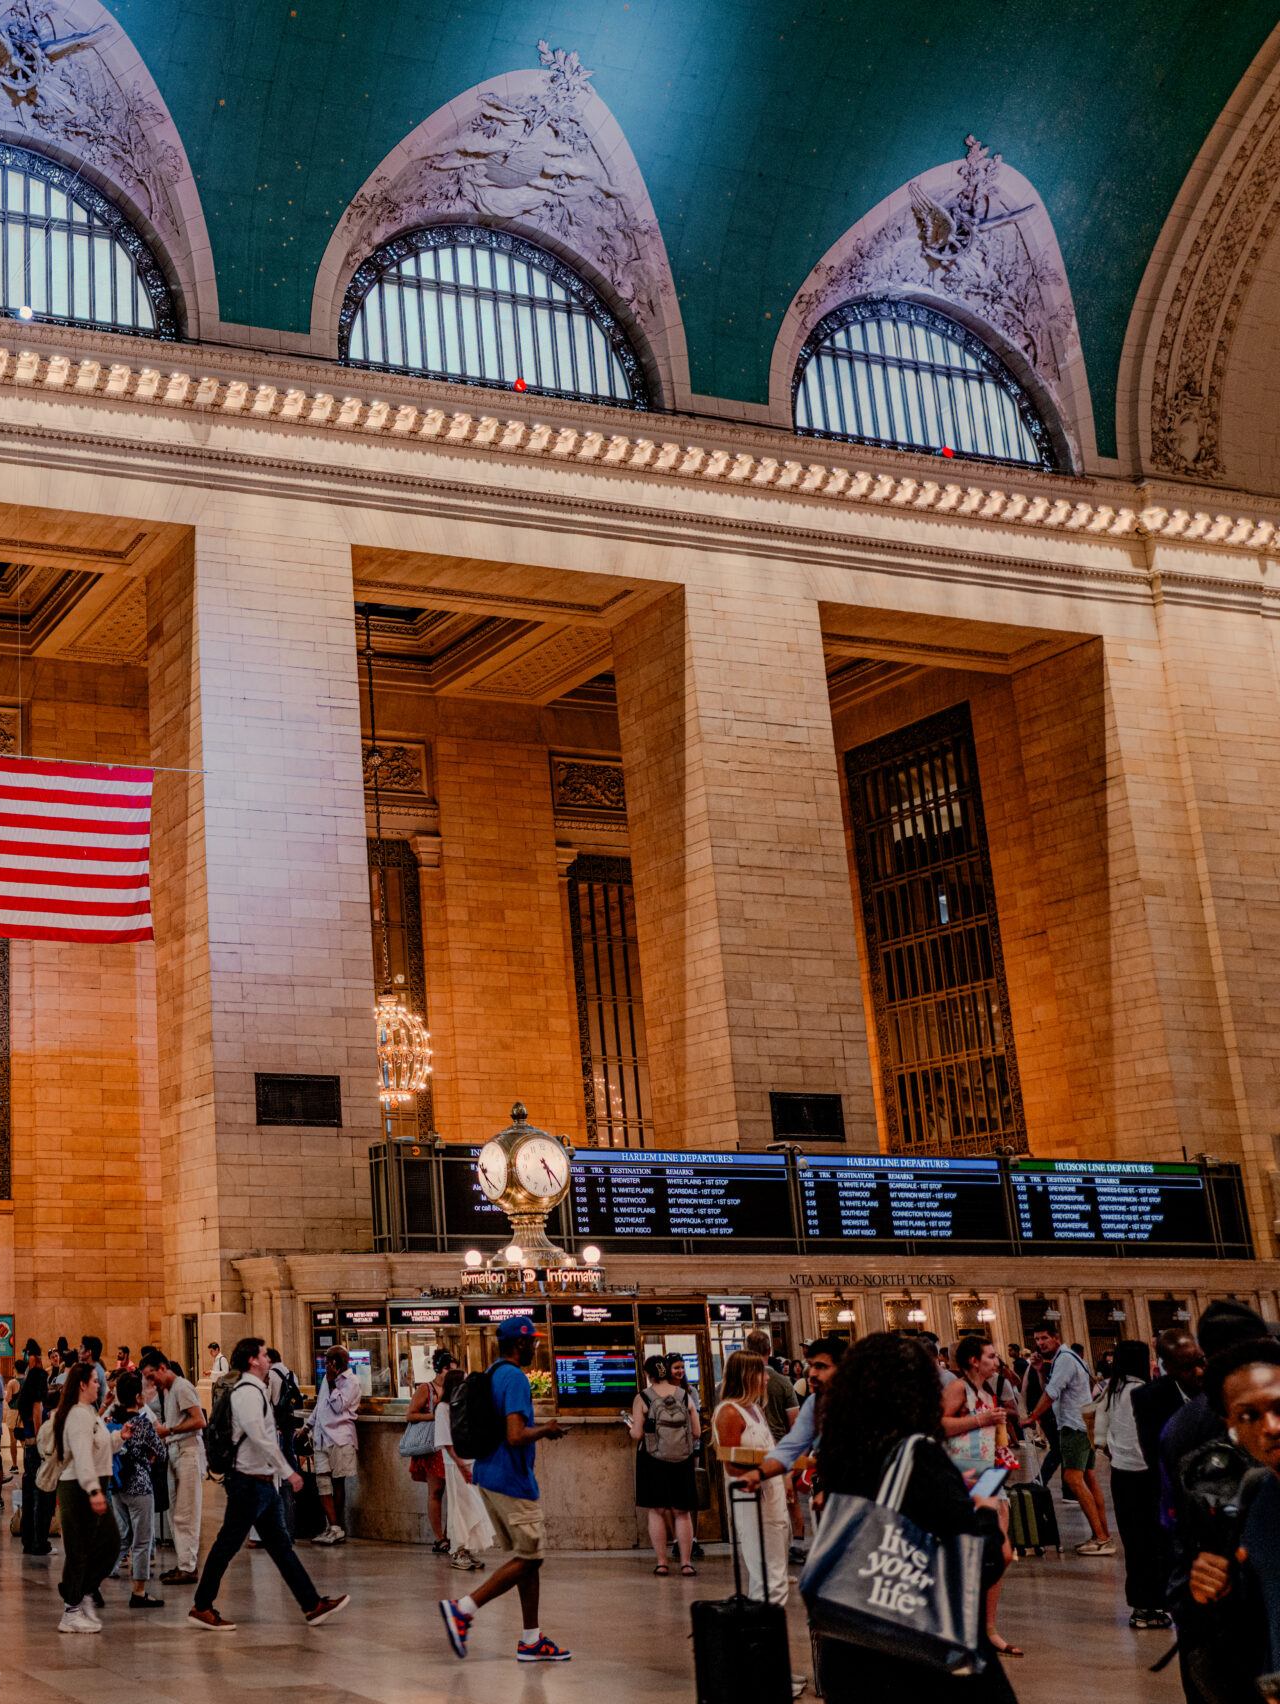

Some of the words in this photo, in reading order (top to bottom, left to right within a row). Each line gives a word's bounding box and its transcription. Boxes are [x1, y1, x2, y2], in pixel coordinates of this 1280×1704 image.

[622, 1154, 656, 1162] HARLEM
[659, 1154, 678, 1163] LINE
[680, 1155, 733, 1164] DEPARTURES
[846, 1158, 879, 1167] HARLEM
[881, 1159, 899, 1168] LINE
[901, 1159, 950, 1169] DEPARTURES
[1054, 1163, 1087, 1172] HUDSON
[1088, 1164, 1105, 1172] LINE
[1107, 1165, 1154, 1174] DEPARTURES
[546, 1269, 601, 1282] Information
[789, 1274, 813, 1285] MTA
[818, 1274, 905, 1286] METRO-NORTH
[908, 1274, 955, 1286] TICKETS
[878, 1524, 928, 1569] live
[858, 1551, 935, 1590] your
